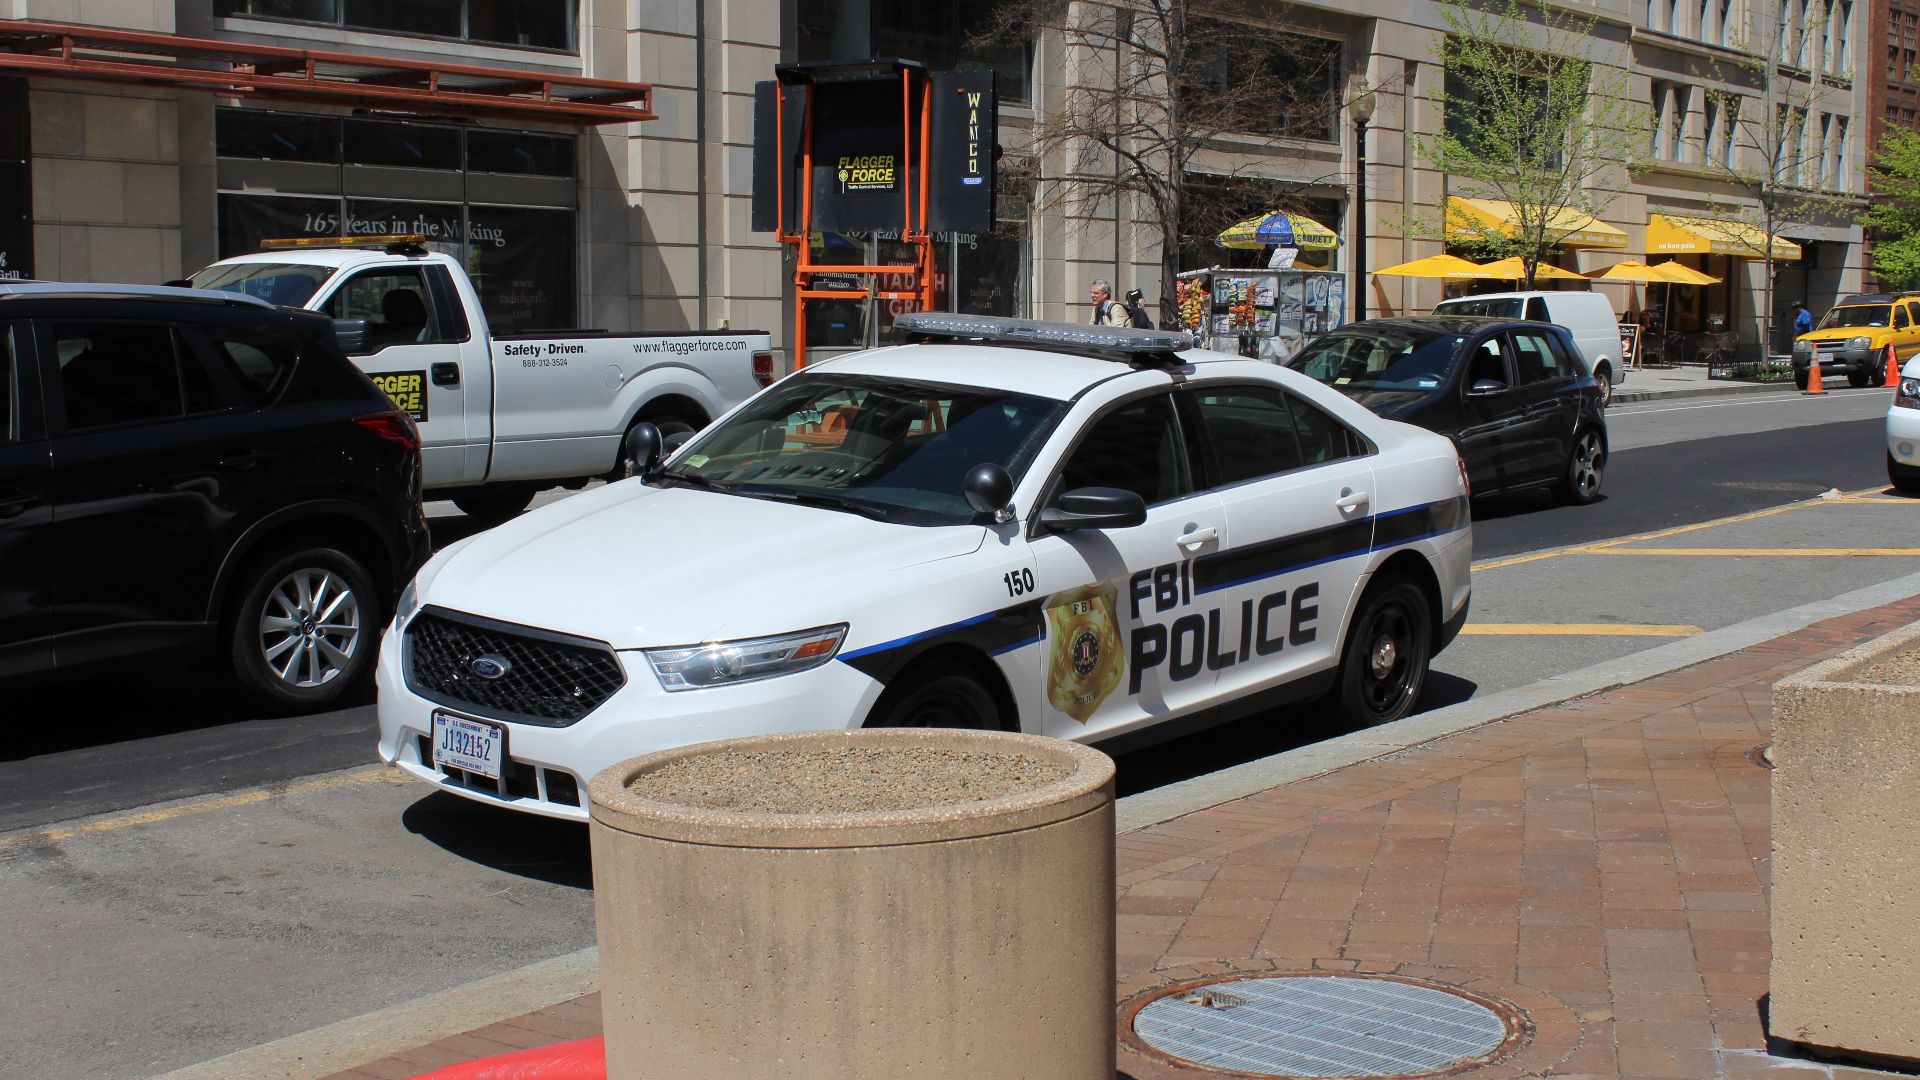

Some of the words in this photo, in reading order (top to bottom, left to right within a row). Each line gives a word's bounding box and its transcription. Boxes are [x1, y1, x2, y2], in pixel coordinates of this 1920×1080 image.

[968, 92, 981, 173] WANCO
[838, 155, 894, 169] FLAGGER
[851, 168, 893, 182] FORCE
[304, 212, 337, 232] 165
[391, 215, 407, 234] in
[412, 214, 439, 236] the
[443, 218, 505, 247] Mking
[936, 231, 978, 249] Mking
[504, 344, 541, 357] Safety
[548, 343, 584, 355] Driven
[633, 340, 747, 355] www.flaggerforce.com
[522, 358, 568, 367] 888-312-3524
[374, 375, 420, 393] GGER
[1003, 567, 1035, 598] 150
[1130, 558, 1191, 620] FBI
[1073, 600, 1093, 615] FBI
[1128, 581, 1320, 696] POLICE
[442, 727, 491, 761] J132152
